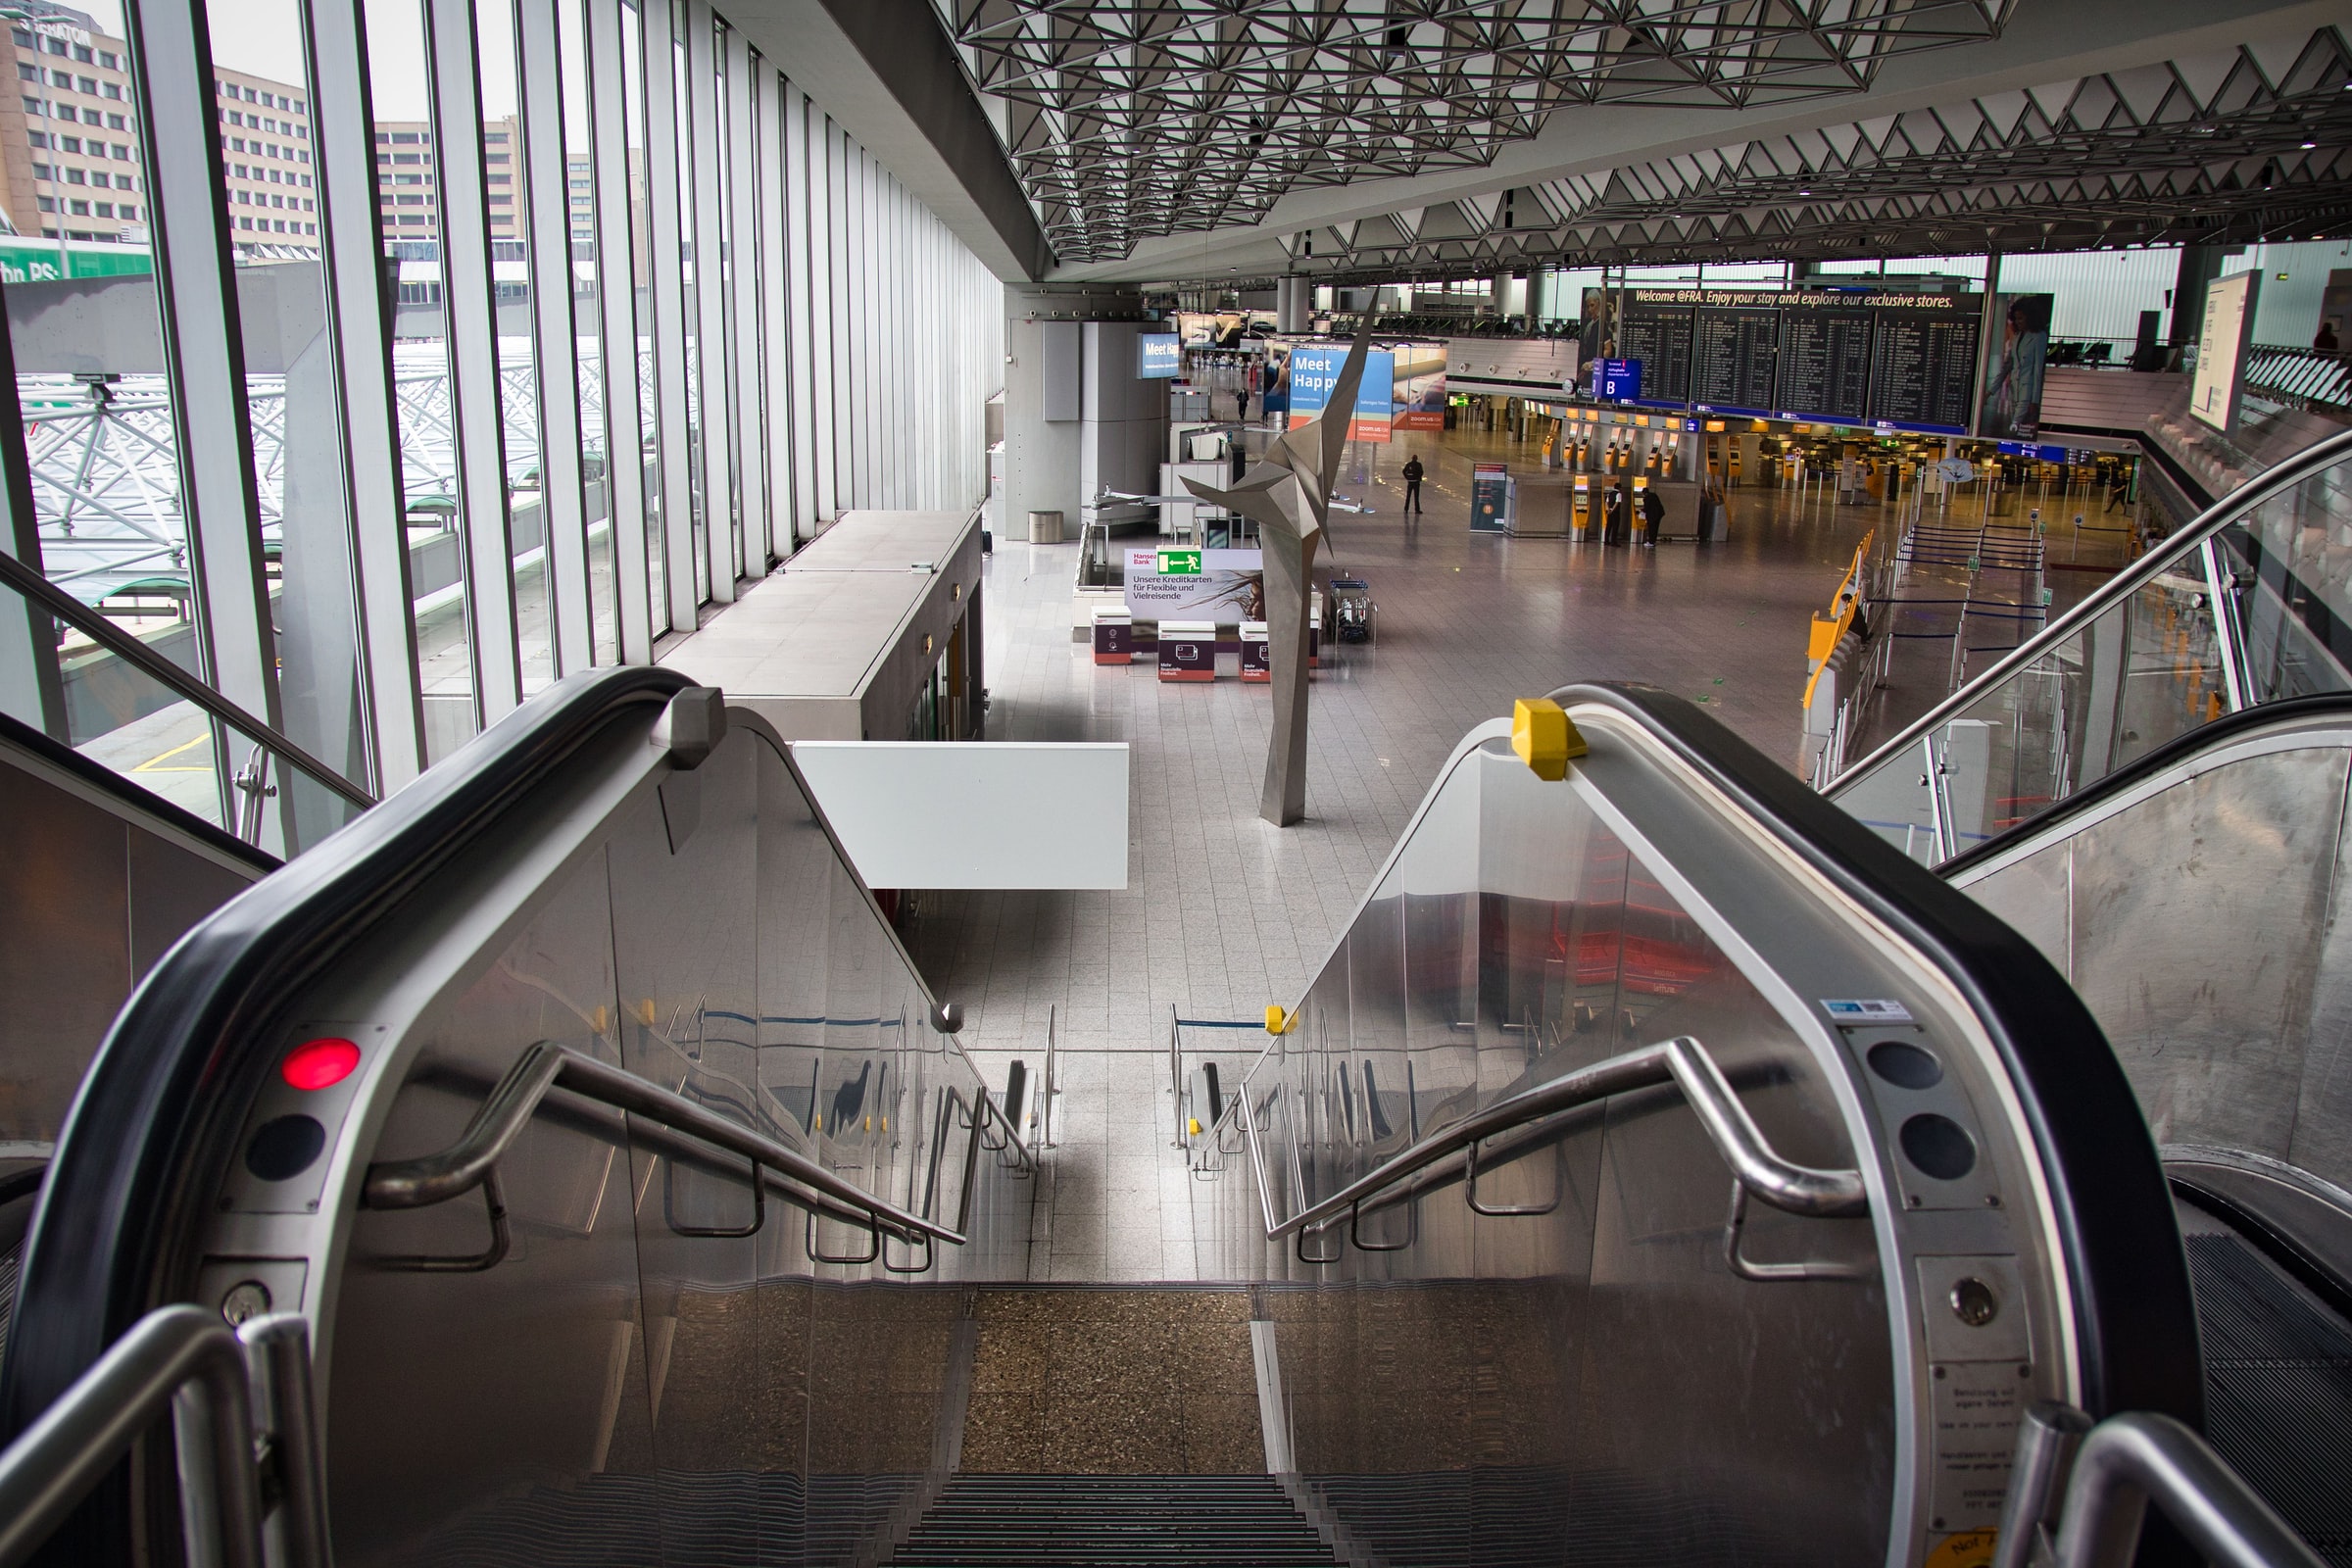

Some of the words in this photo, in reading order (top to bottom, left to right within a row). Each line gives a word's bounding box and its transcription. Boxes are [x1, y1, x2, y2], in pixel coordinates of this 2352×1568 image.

[1636, 289, 1675, 303] Welcome
[1677, 290, 1704, 303] @FRA.
[1706, 291, 1732, 307] Enjoy
[1733, 294, 1754, 307] your
[1757, 292, 1776, 307] stay
[1779, 292, 1799, 305] and
[1801, 292, 1840, 309] explore
[1842, 295, 1862, 306] our
[1864, 292, 1915, 308] exclusive
[1915, 294, 1953, 308] stores.
[1145, 343, 1166, 357] Meet
[1295, 357, 1331, 371] Meet
[1295, 373, 1338, 392] Happ
[1606, 380, 1616, 395] B
[1133, 583, 1145, 592] für
[1147, 583, 1177, 592] Flexible
[1178, 583, 1195, 592] und
